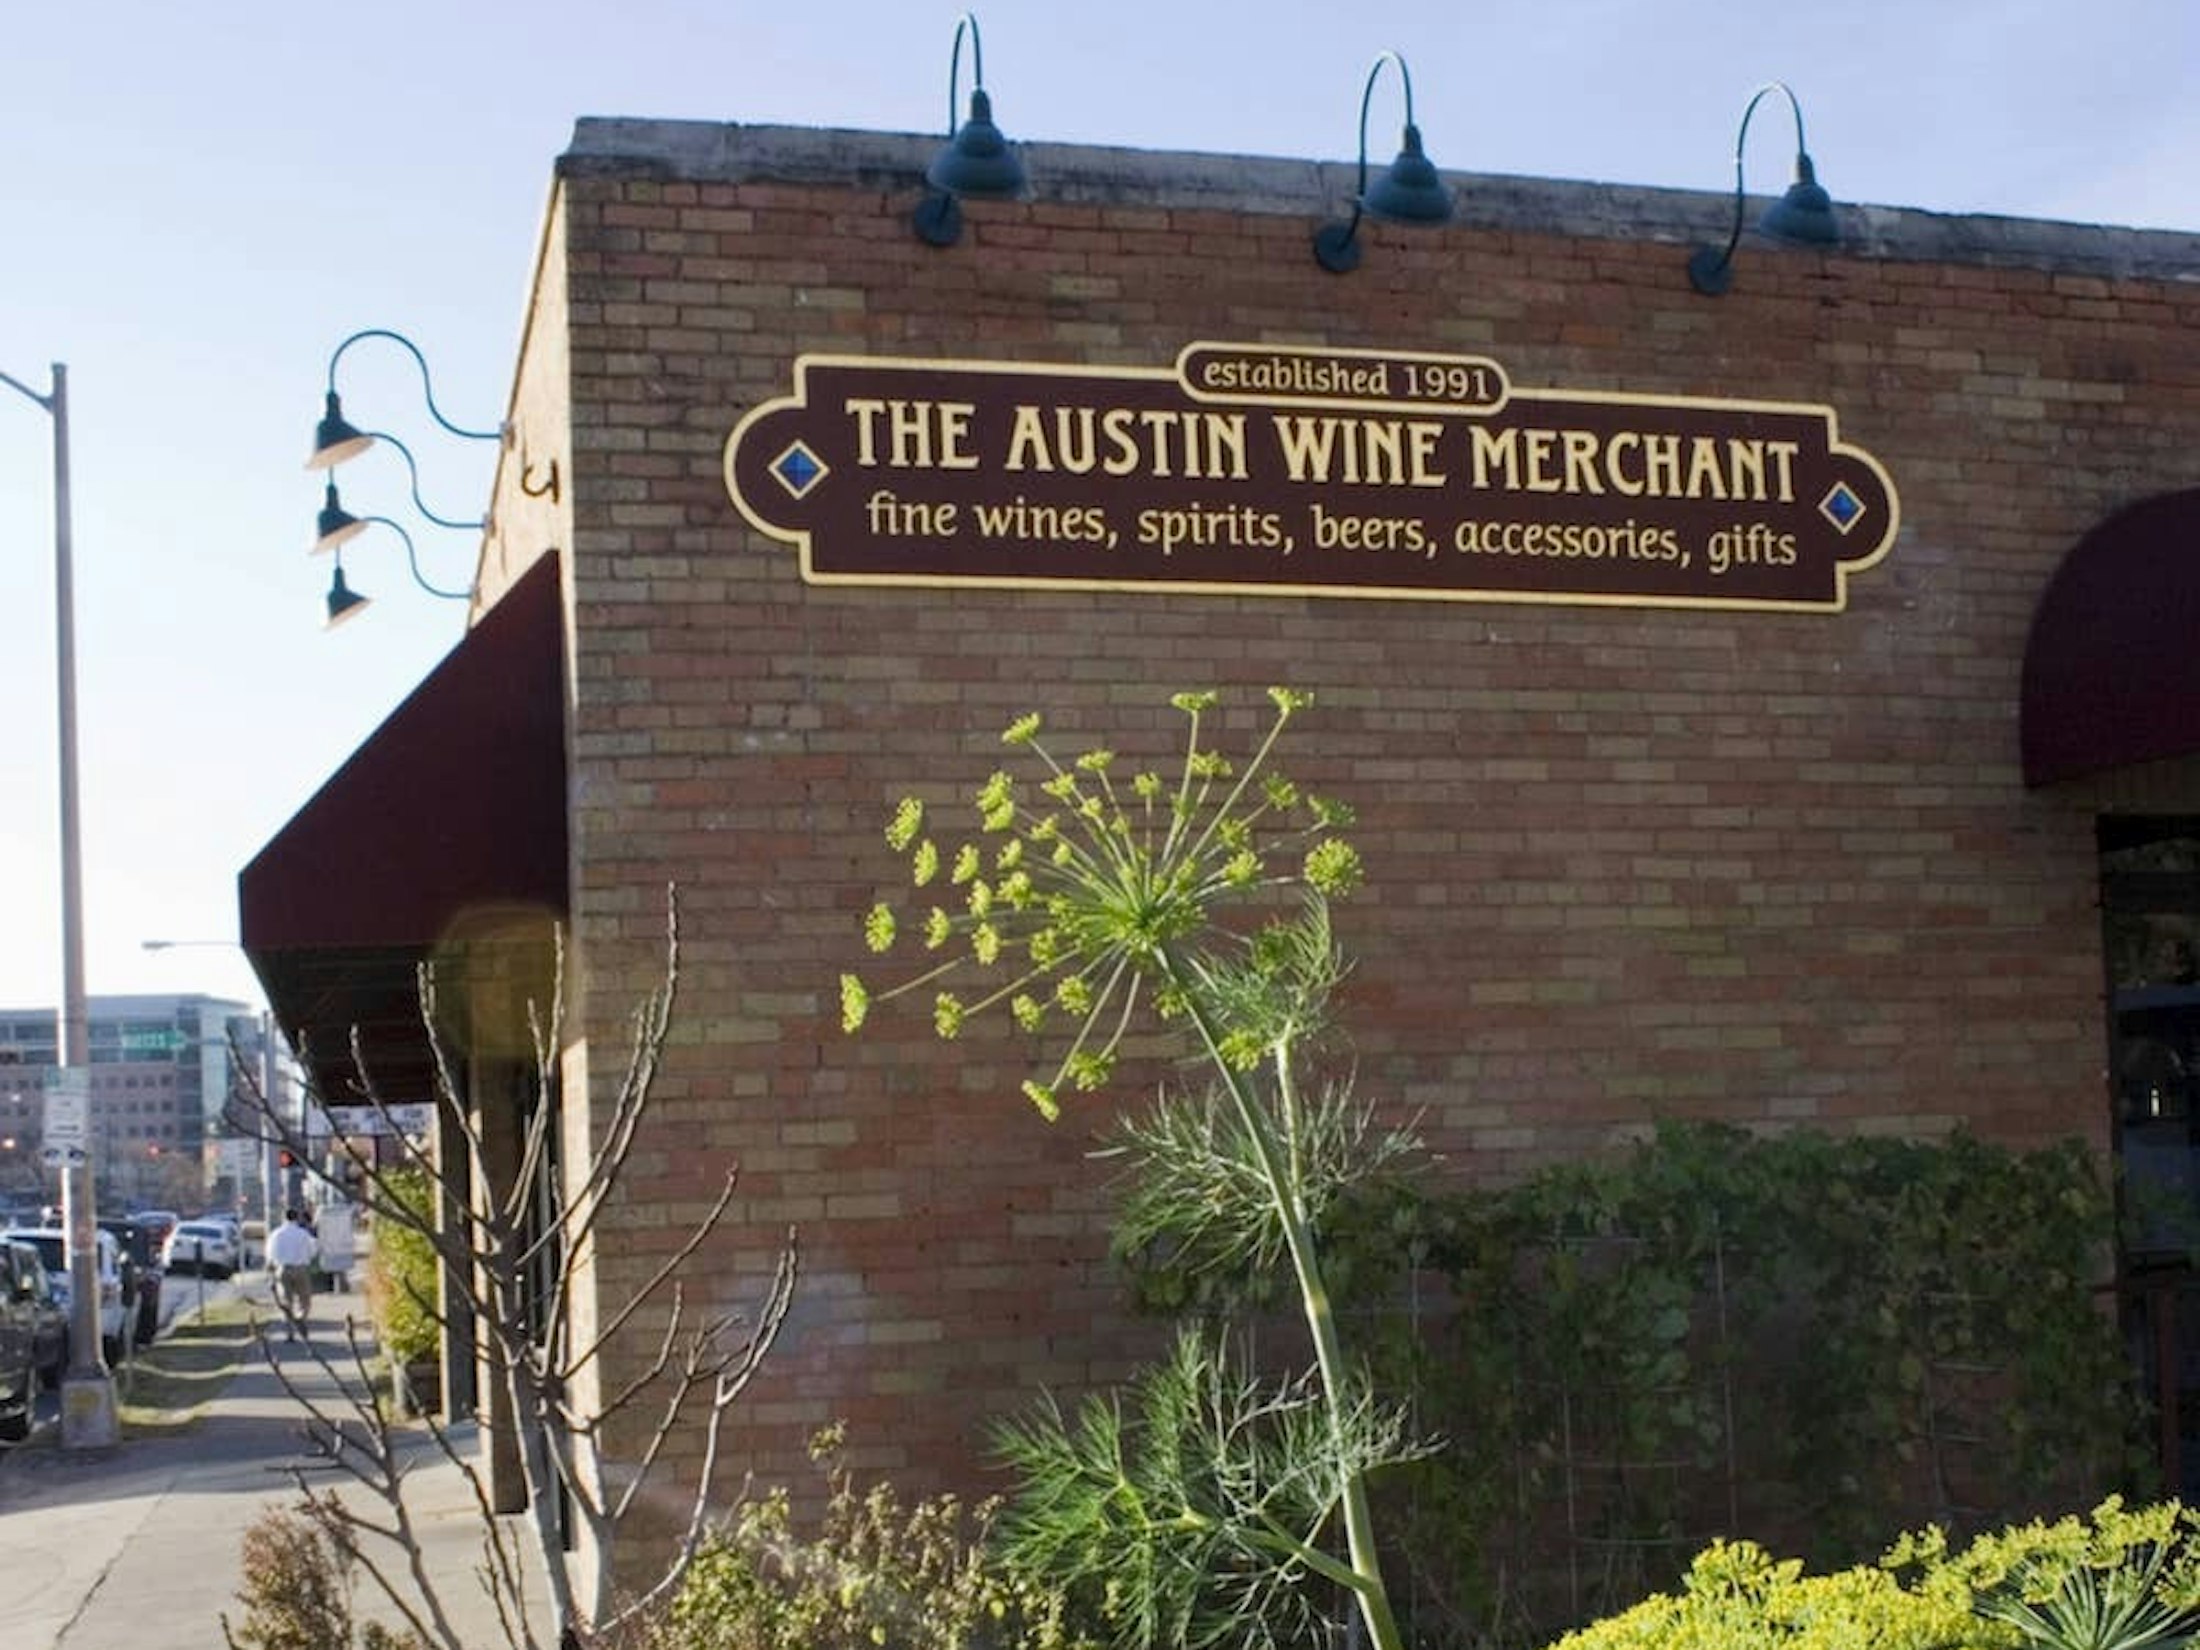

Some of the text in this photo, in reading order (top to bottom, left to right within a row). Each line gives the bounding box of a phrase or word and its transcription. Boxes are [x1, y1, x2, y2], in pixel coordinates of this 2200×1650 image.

[1204, 358, 1489, 400] established 1991
[846, 399, 1799, 502] THE AUSTIN WINE MERCHANT
[866, 490, 1797, 574] fine wines, spirits, beers, accessories, gifts
